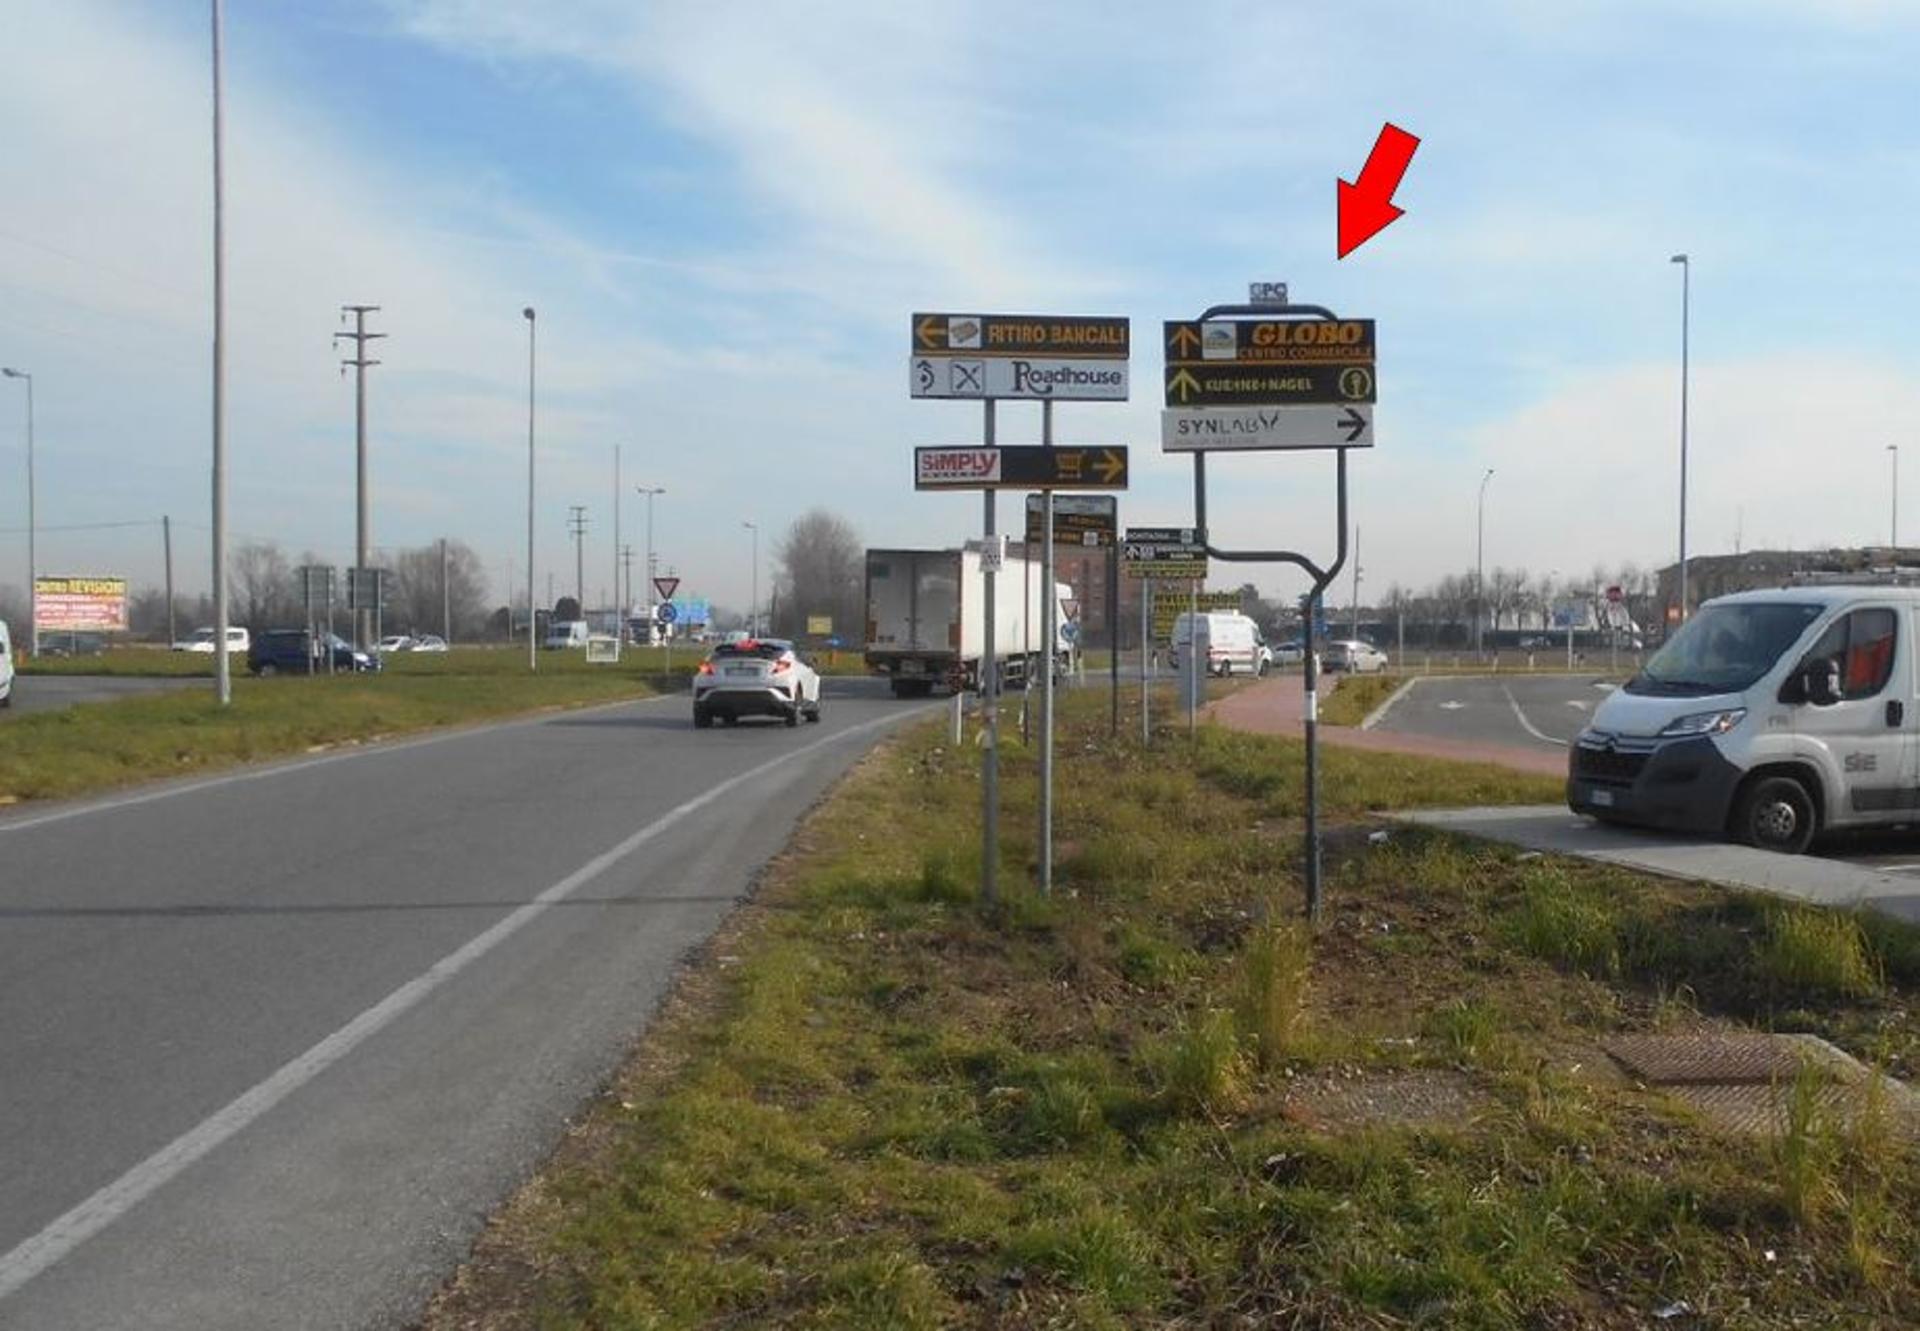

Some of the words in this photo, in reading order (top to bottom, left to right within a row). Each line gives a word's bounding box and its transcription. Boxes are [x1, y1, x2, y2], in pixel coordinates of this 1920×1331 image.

[988, 324, 1046, 343] RITIRO
[1051, 326, 1125, 345] BANCALI
[1252, 322, 1362, 345] GLOBO
[1011, 361, 1123, 395] Roadhouse
